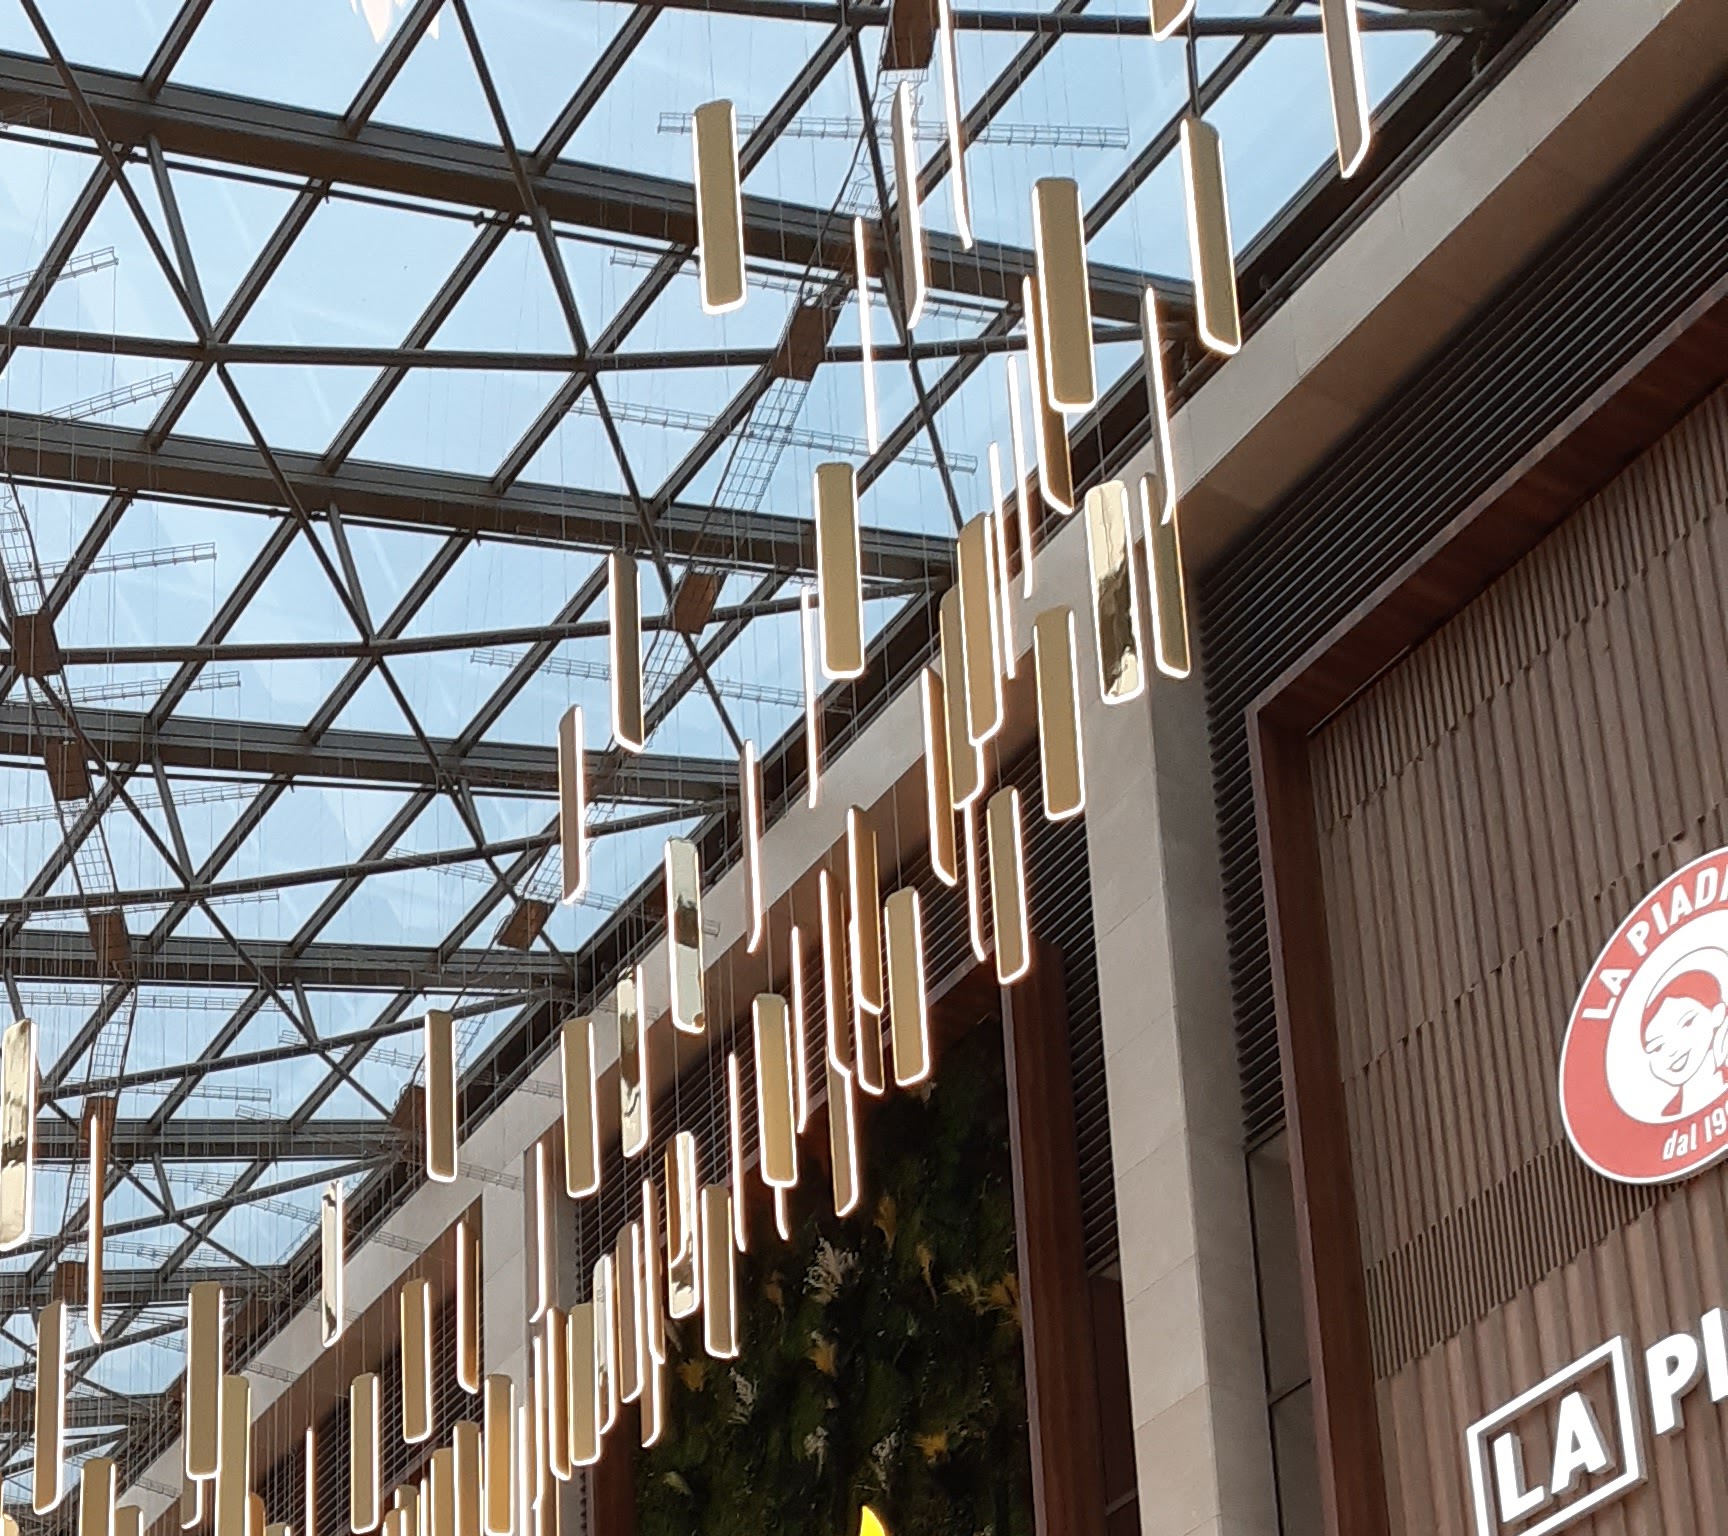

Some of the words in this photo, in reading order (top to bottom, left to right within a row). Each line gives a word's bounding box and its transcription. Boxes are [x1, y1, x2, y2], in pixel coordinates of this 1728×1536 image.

[1581, 968, 1632, 1020] LA
[1625, 864, 1728, 957] PIAD
[1661, 1124, 1698, 1161] dal
[1493, 1391, 1610, 1524] LA
